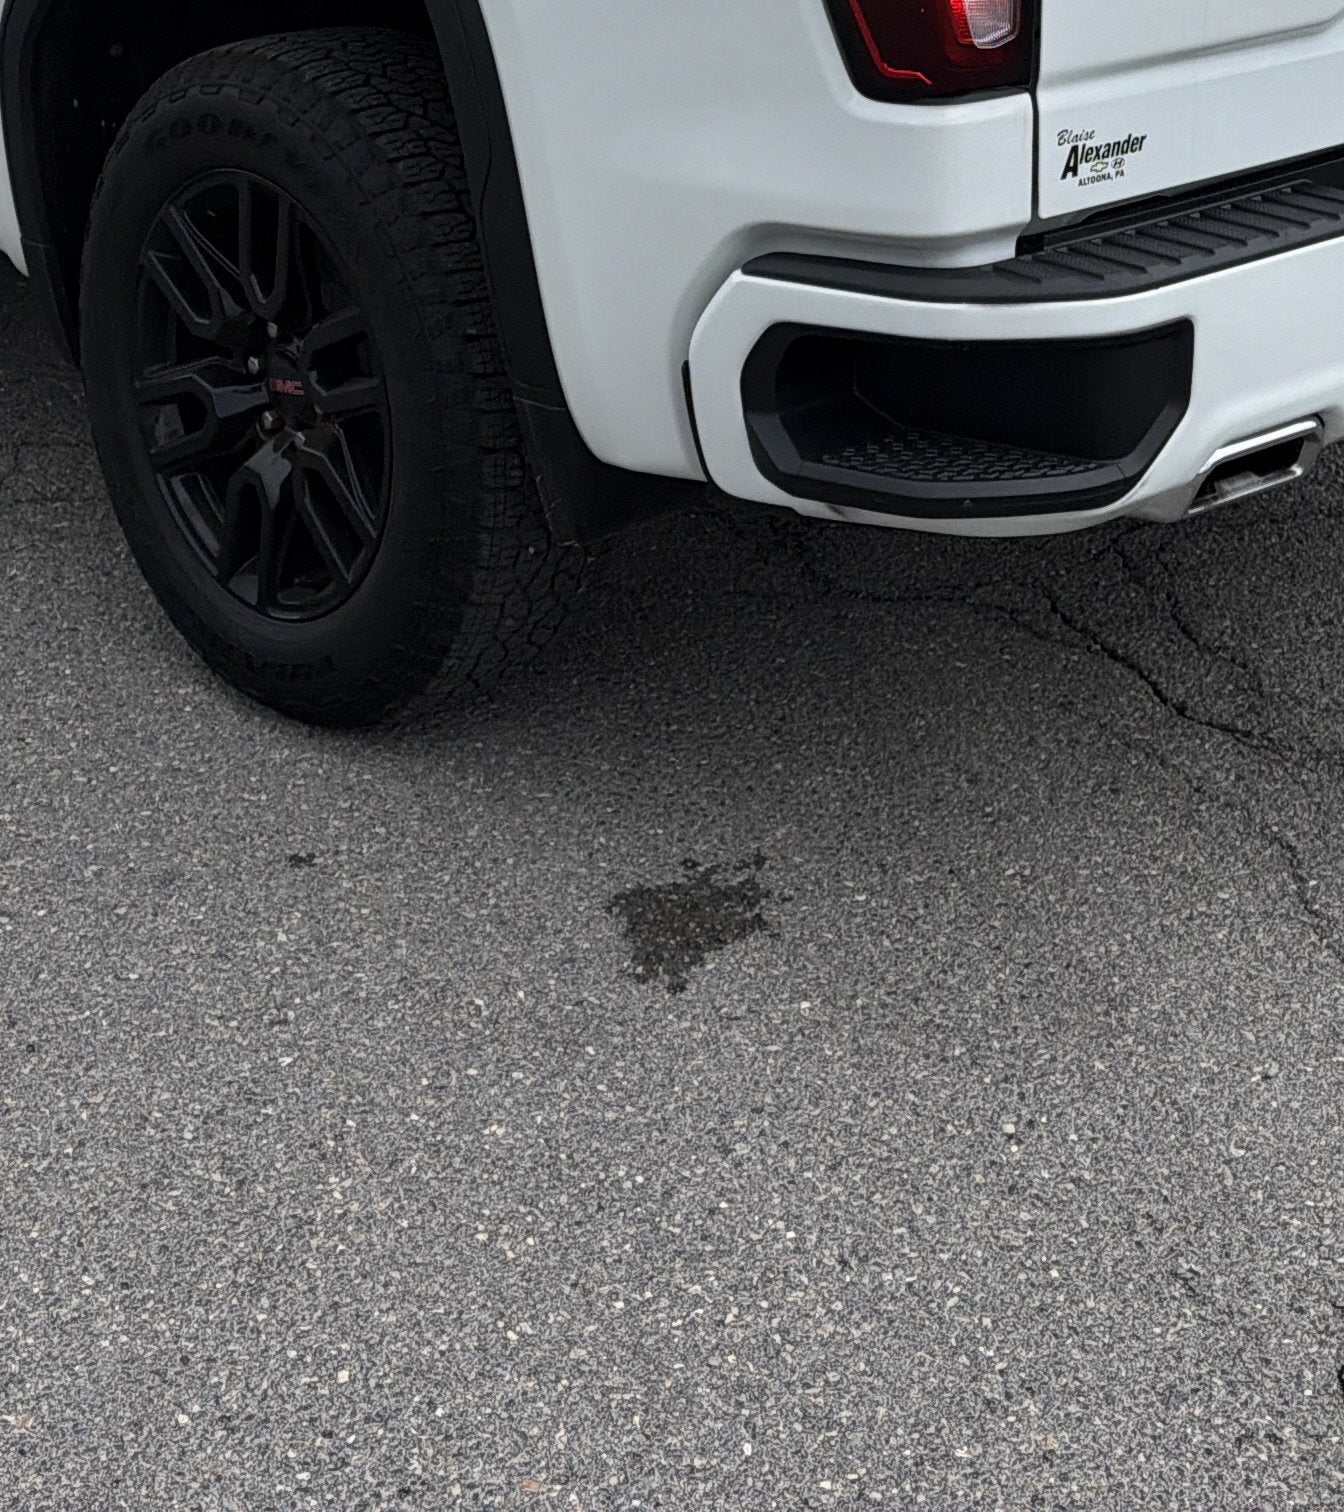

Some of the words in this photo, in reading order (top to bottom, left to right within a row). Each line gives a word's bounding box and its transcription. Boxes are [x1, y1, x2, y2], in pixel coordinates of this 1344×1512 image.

[1057, 129, 1096, 146] Blaise
[1060, 133, 1147, 180] Alexander
[1115, 169, 1125, 179] PA
